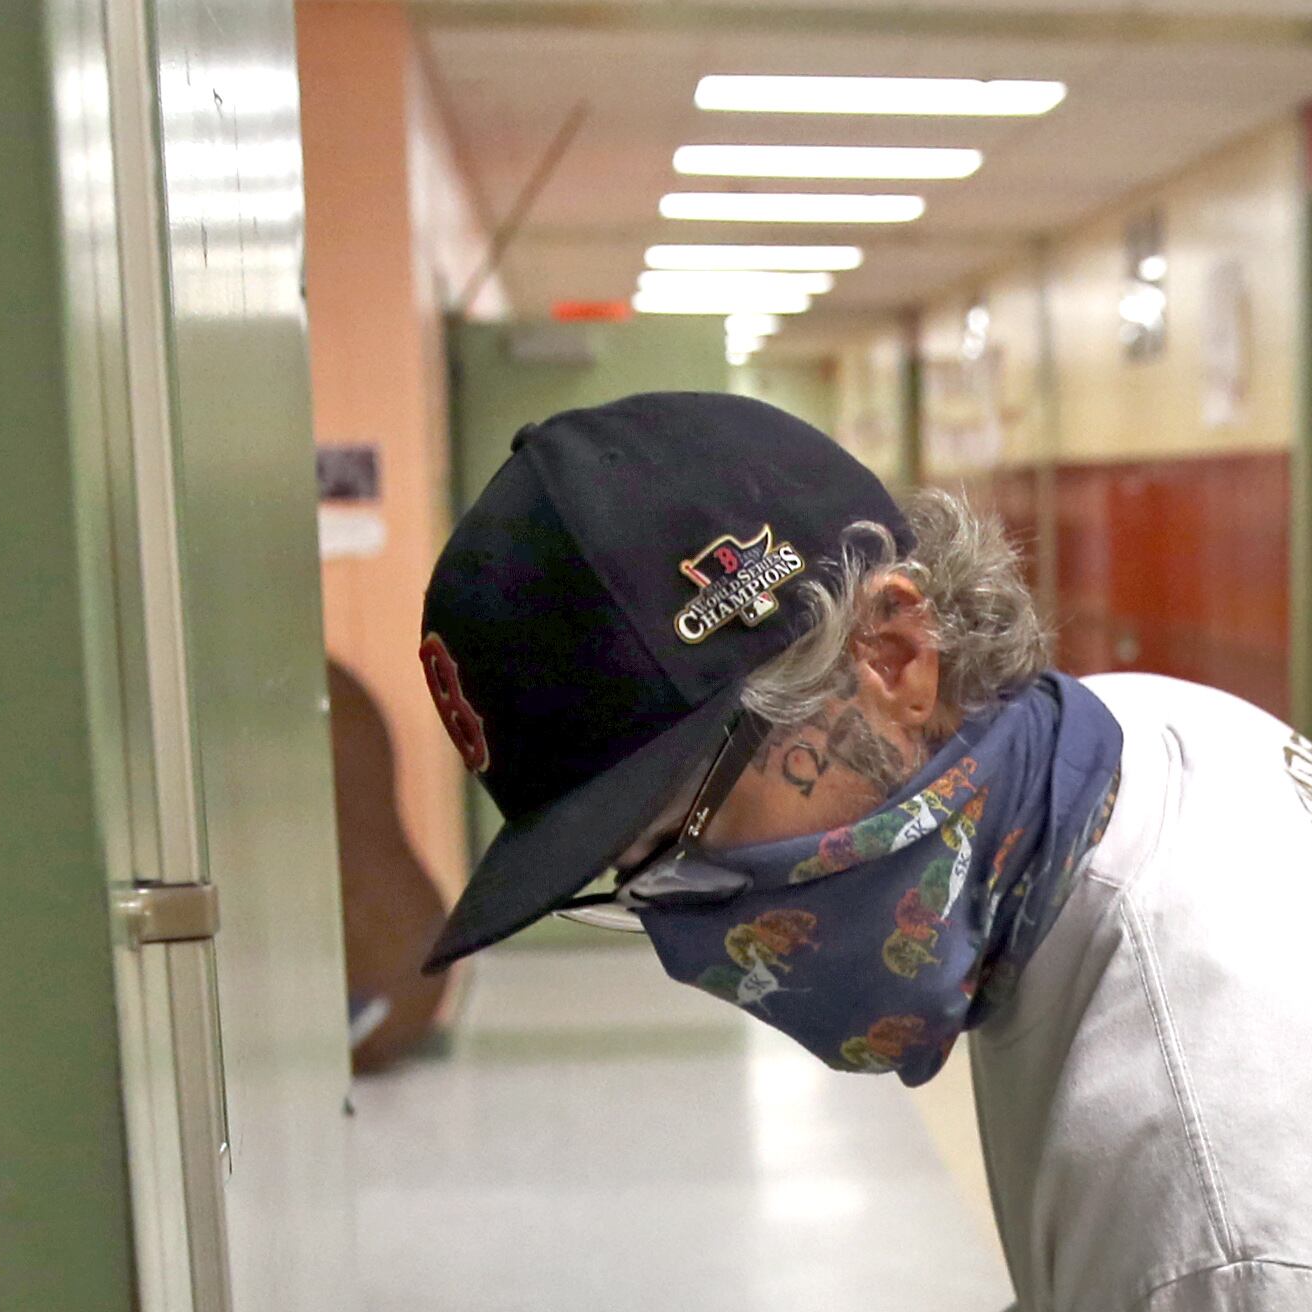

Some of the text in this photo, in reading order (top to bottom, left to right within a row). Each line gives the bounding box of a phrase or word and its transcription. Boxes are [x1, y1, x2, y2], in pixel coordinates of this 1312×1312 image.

[678, 545, 802, 639] CHAMPIONS
[691, 554, 782, 614] WORLD SERIES
[903, 819, 929, 842] 5K
[954, 852, 971, 877] 5K
[744, 973, 772, 996] 5K
